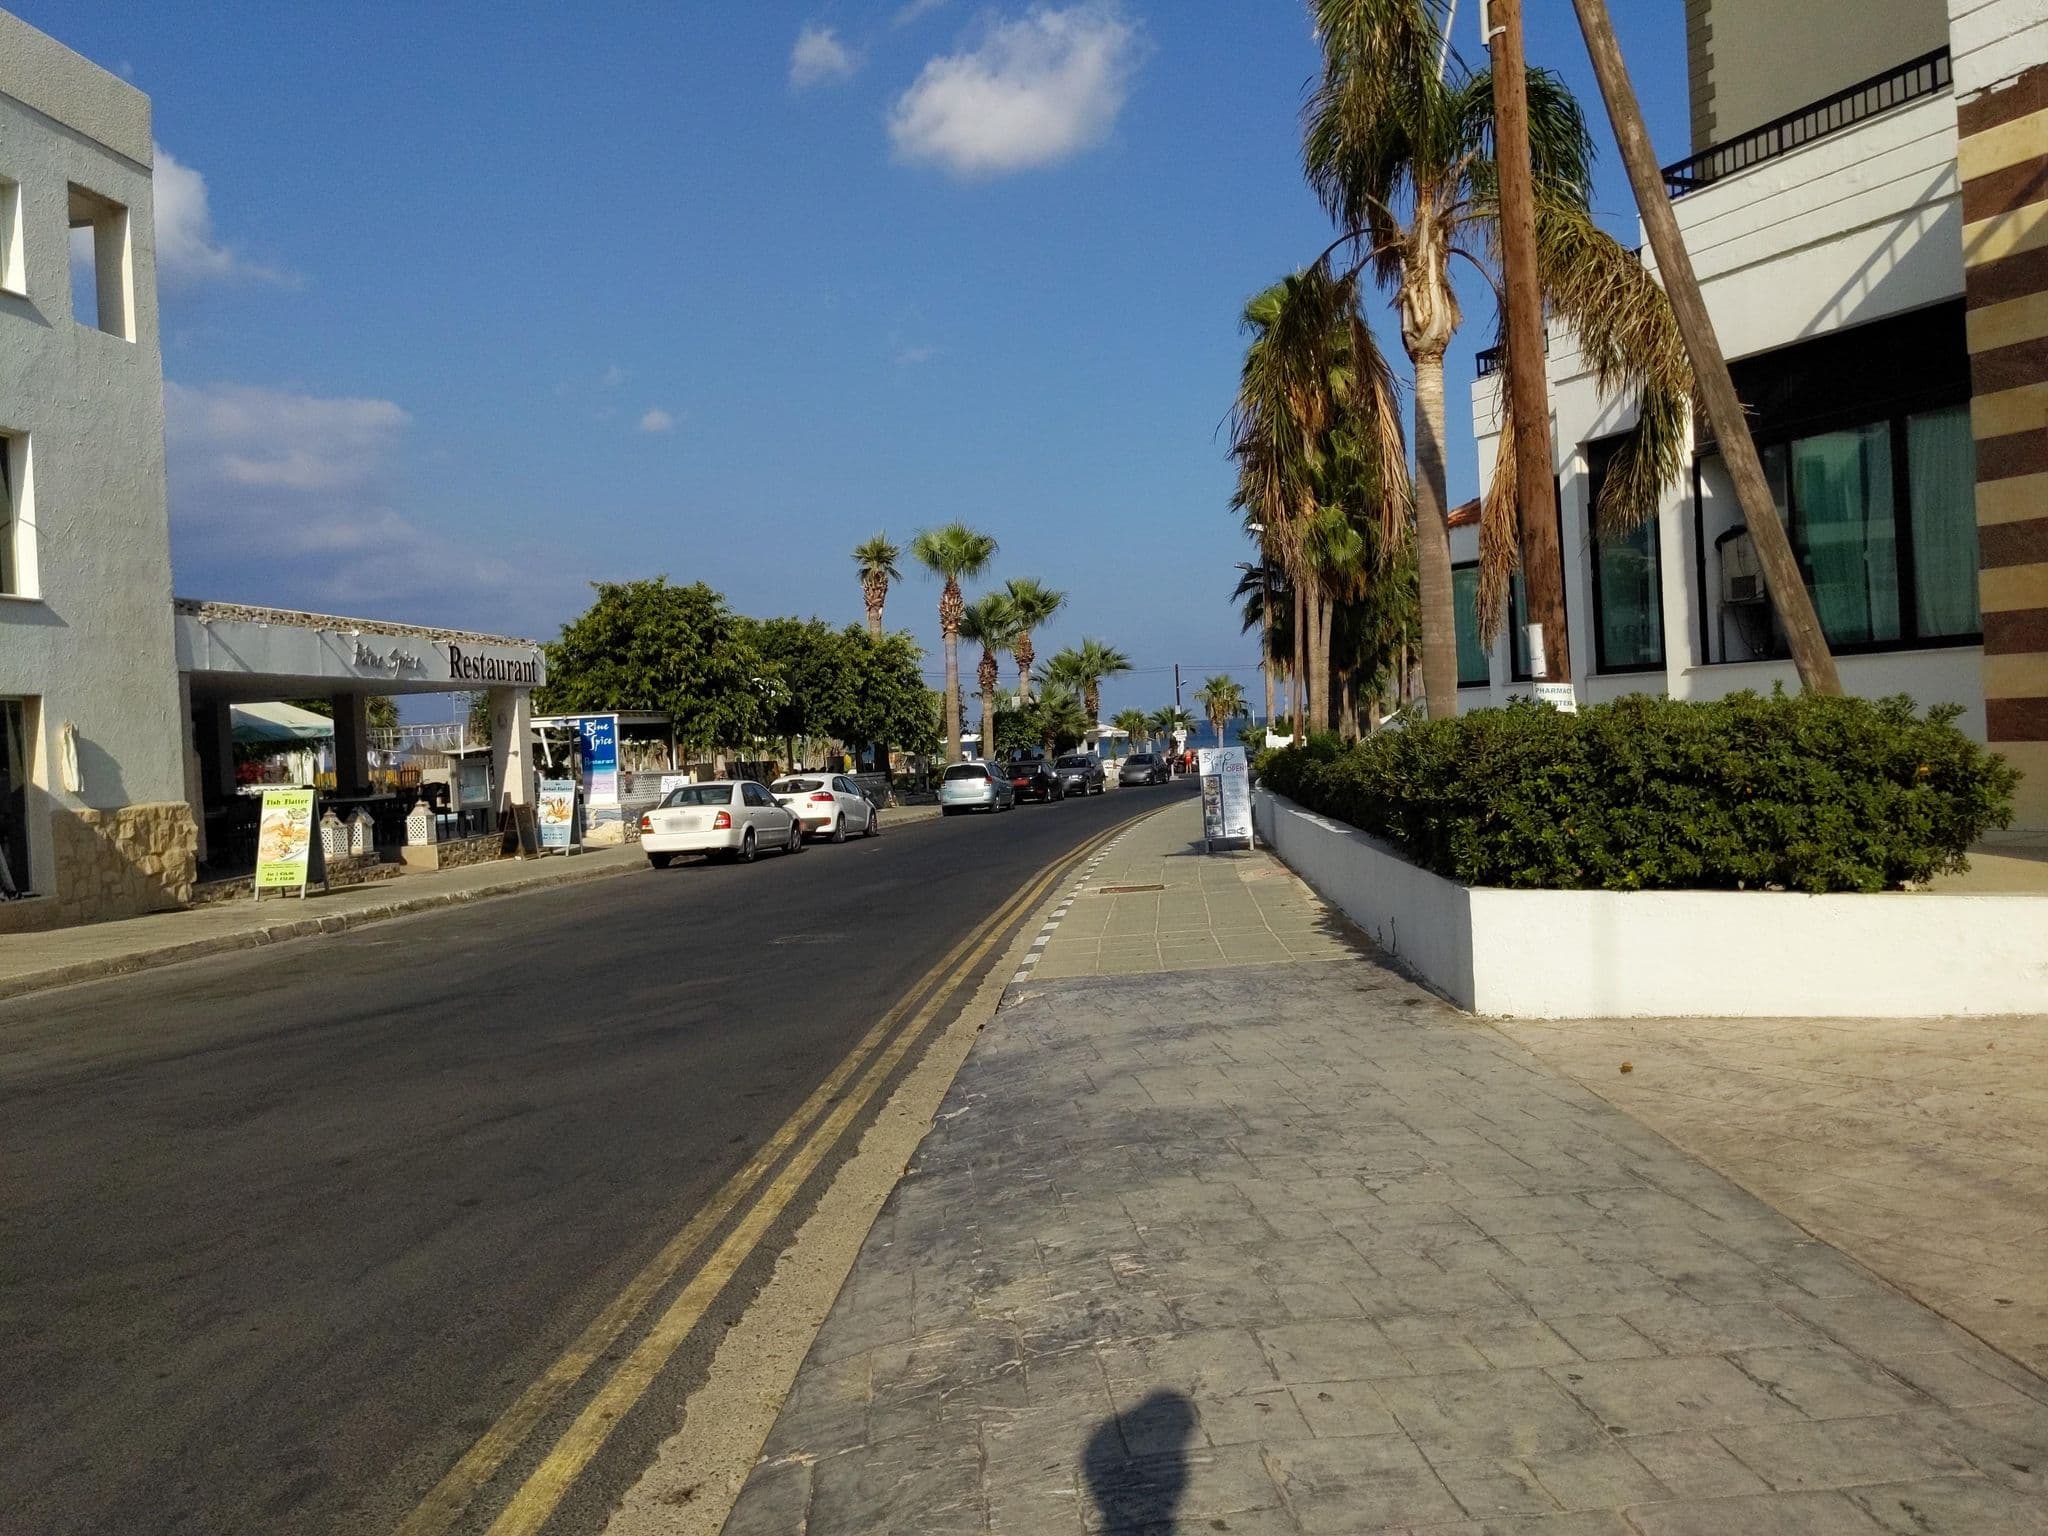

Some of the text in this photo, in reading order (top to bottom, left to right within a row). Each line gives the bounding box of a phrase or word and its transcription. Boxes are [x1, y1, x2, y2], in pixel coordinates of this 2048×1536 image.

[448, 645, 537, 683] Restaurant
[583, 719, 610, 737] Blue
[589, 734, 614, 752] Spice
[1225, 765, 1244, 773] OPEN
